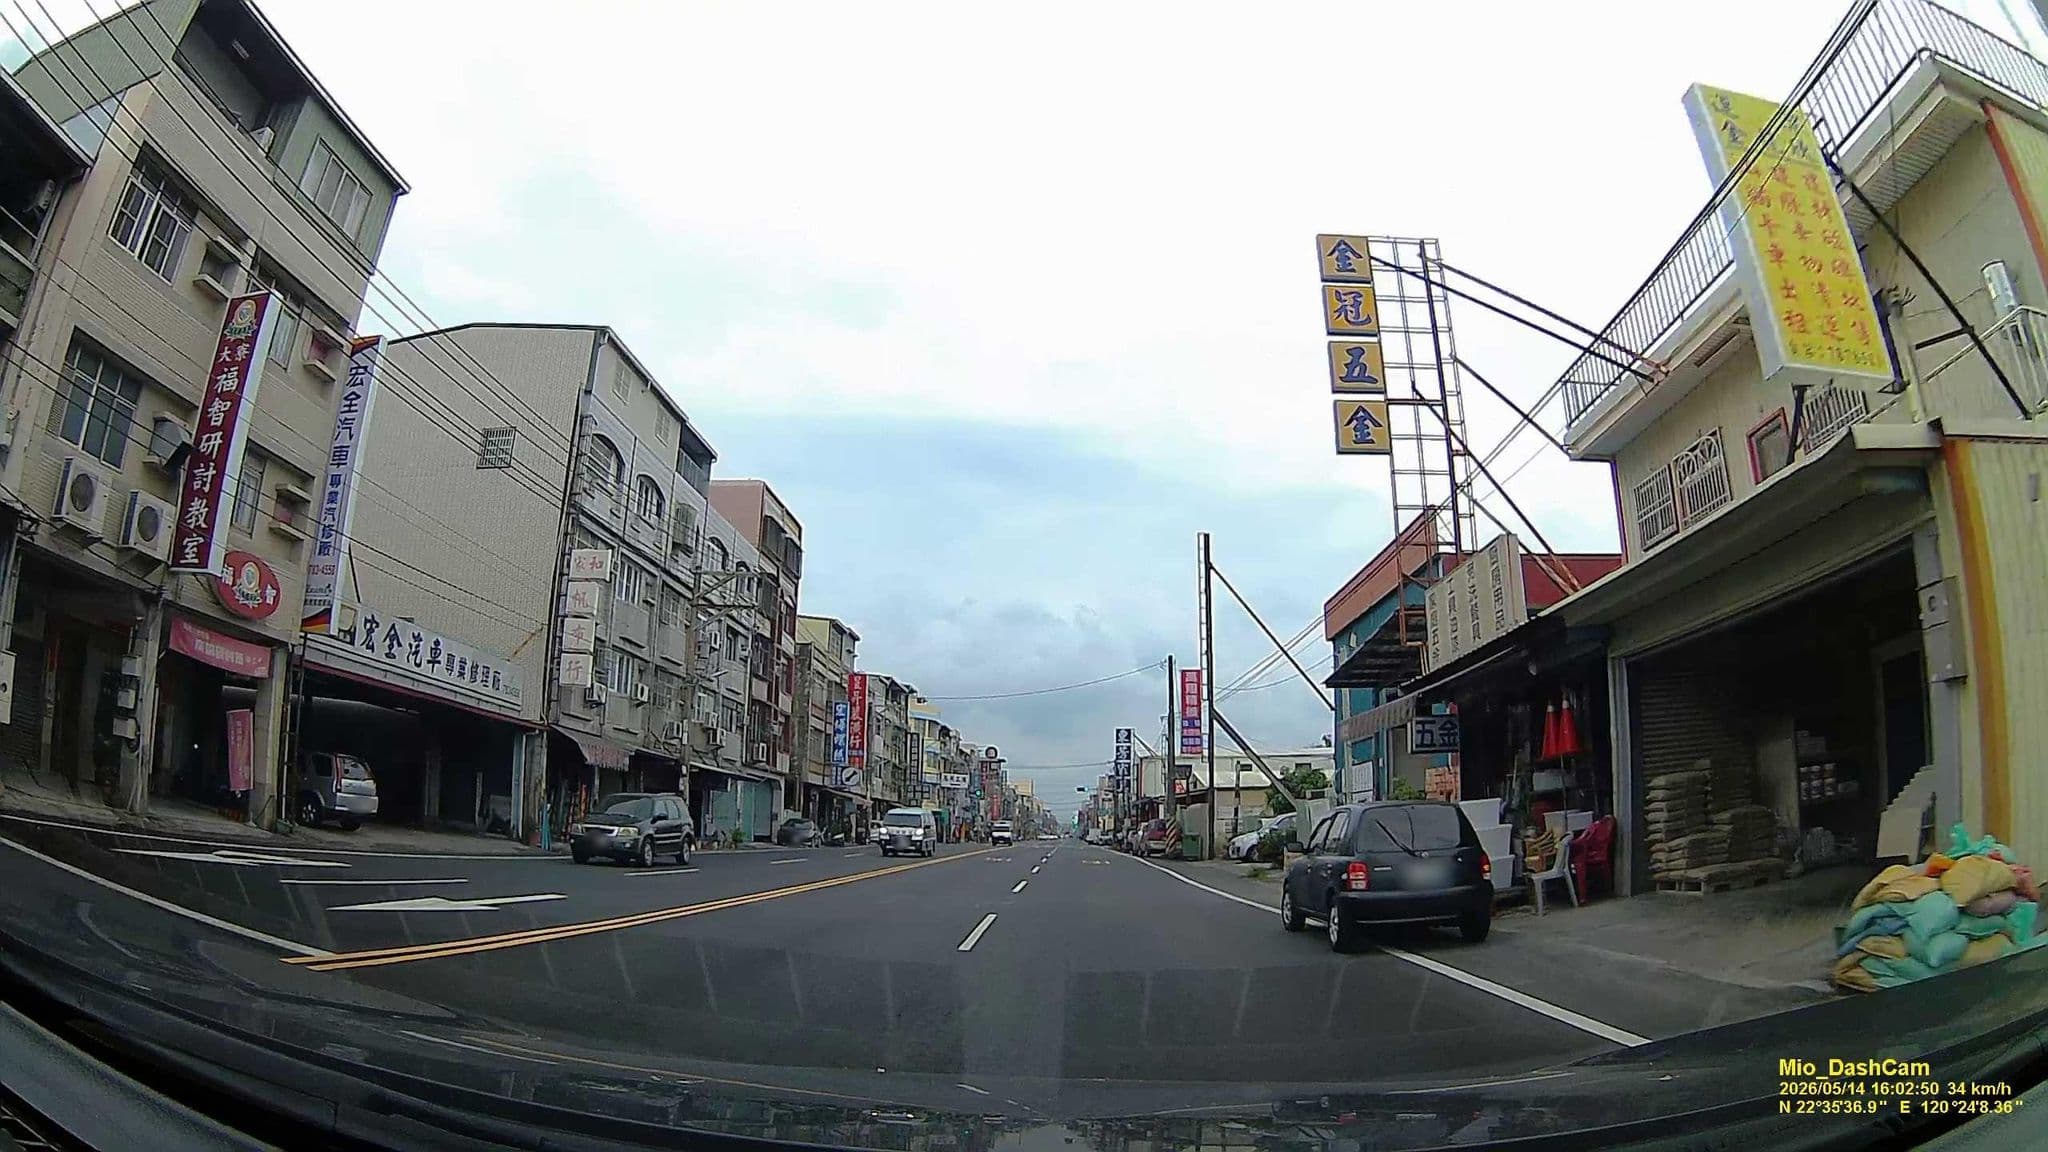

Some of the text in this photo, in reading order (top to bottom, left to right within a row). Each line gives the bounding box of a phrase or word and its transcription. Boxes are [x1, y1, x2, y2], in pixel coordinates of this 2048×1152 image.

[1327, 239, 1384, 444] 金冠五金
[179, 367, 240, 565] 福智研討教室
[360, 613, 442, 675] 宏全汽車
[444, 653, 502, 691] 專業修理廠
[1415, 719, 1460, 748] 五金
